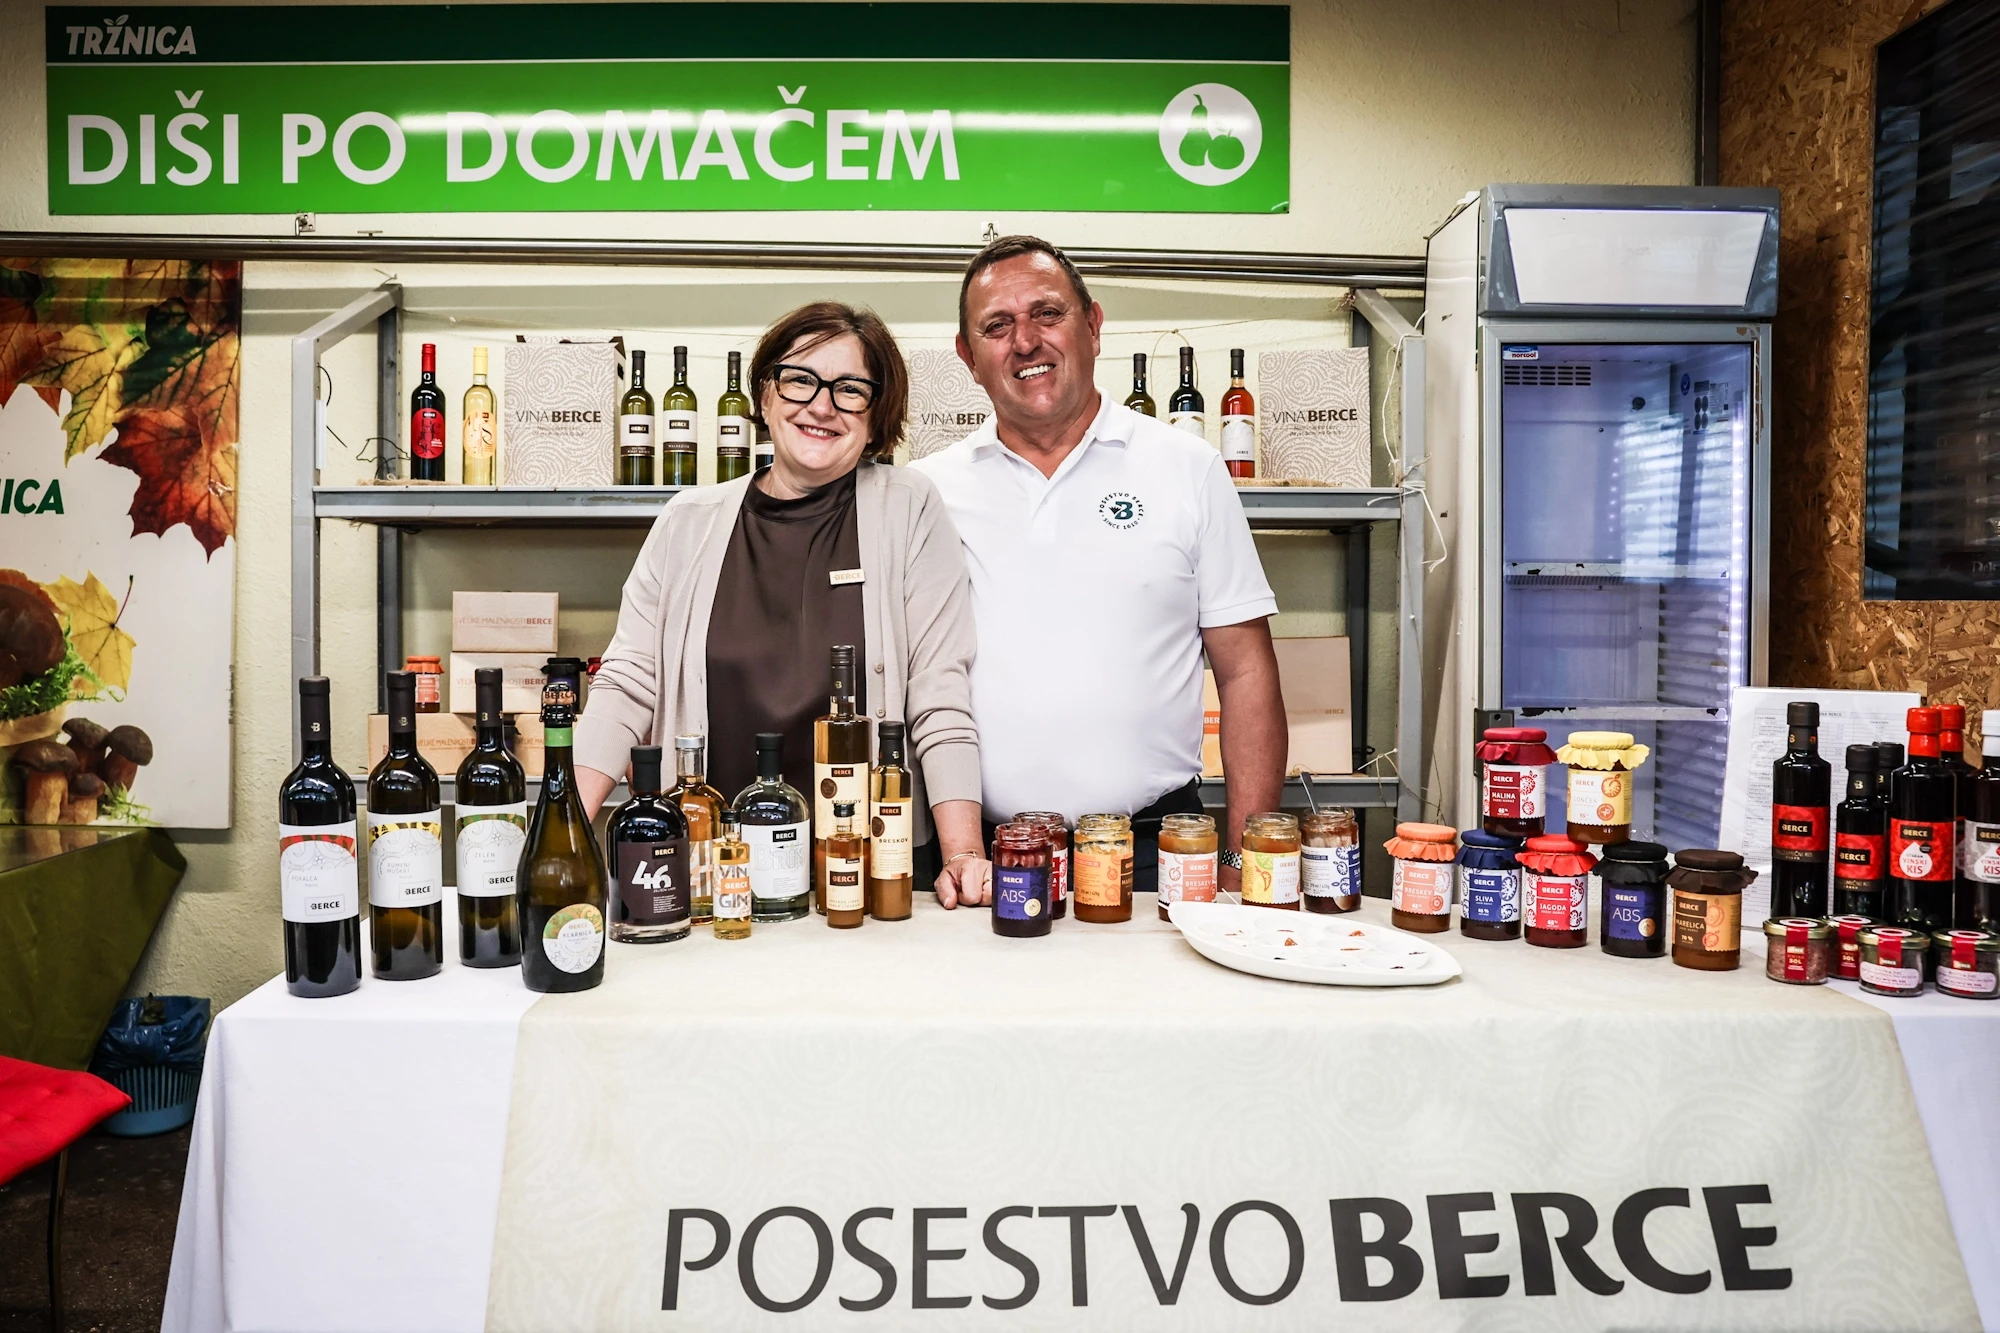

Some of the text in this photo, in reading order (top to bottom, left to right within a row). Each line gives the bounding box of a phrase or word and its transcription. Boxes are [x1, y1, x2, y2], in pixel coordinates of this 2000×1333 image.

[66, 15, 197, 55] TRŽNICA
[67, 86, 960, 186] DIŠI PO DOMAČEM
[515, 410, 602, 423] VINA BERCE
[921, 412, 990, 425] VINA BER
[1271, 408, 1358, 424] VINA BERCE
[0, 479, 64, 515] ICA
[1098, 492, 1130, 513] POSESTVO
[1102, 517, 1120, 530] SINCE
[526, 617, 552, 625] BERCE
[1492, 775, 1514, 783] BERCE
[1492, 791, 1516, 800] MALINA
[1781, 823, 1808, 833] BERCE
[1903, 829, 1928, 837] BERCE
[775, 831, 794, 840] BERCE
[655, 847, 675, 856] BERCE
[1839, 852, 1866, 861] BERCE
[1902, 857, 1928, 865] VINSKI
[719, 866, 747, 879] VIN
[1906, 864, 1923, 874] KIS
[488, 875, 515, 885] BERCE
[631, 860, 672, 890] 46
[832, 875, 856, 883] BERCE
[1002, 876, 1024, 884] BERCE
[724, 880, 748, 890] BERCE
[1185, 879, 1211, 887] BRESKEV
[1474, 879, 1495, 887] BERCE
[404, 885, 431, 896] BERCE
[1404, 887, 1432, 896] BRESKEV
[1541, 886, 1564, 895] BERCE
[719, 894, 748, 909] GIN
[1000, 889, 1027, 904] ABS
[1475, 895, 1494, 903] SLIVA
[1615, 894, 1638, 902] BERCE
[310, 900, 341, 910] BERCE
[1539, 903, 1567, 911] JAGODA
[1678, 902, 1699, 911] BERCE
[1612, 907, 1641, 923] ABS
[1676, 919, 1705, 929] MARELICA
[562, 930, 592, 938] KLARNICA
[661, 1183, 1793, 1312] POSESTVO BERCE
